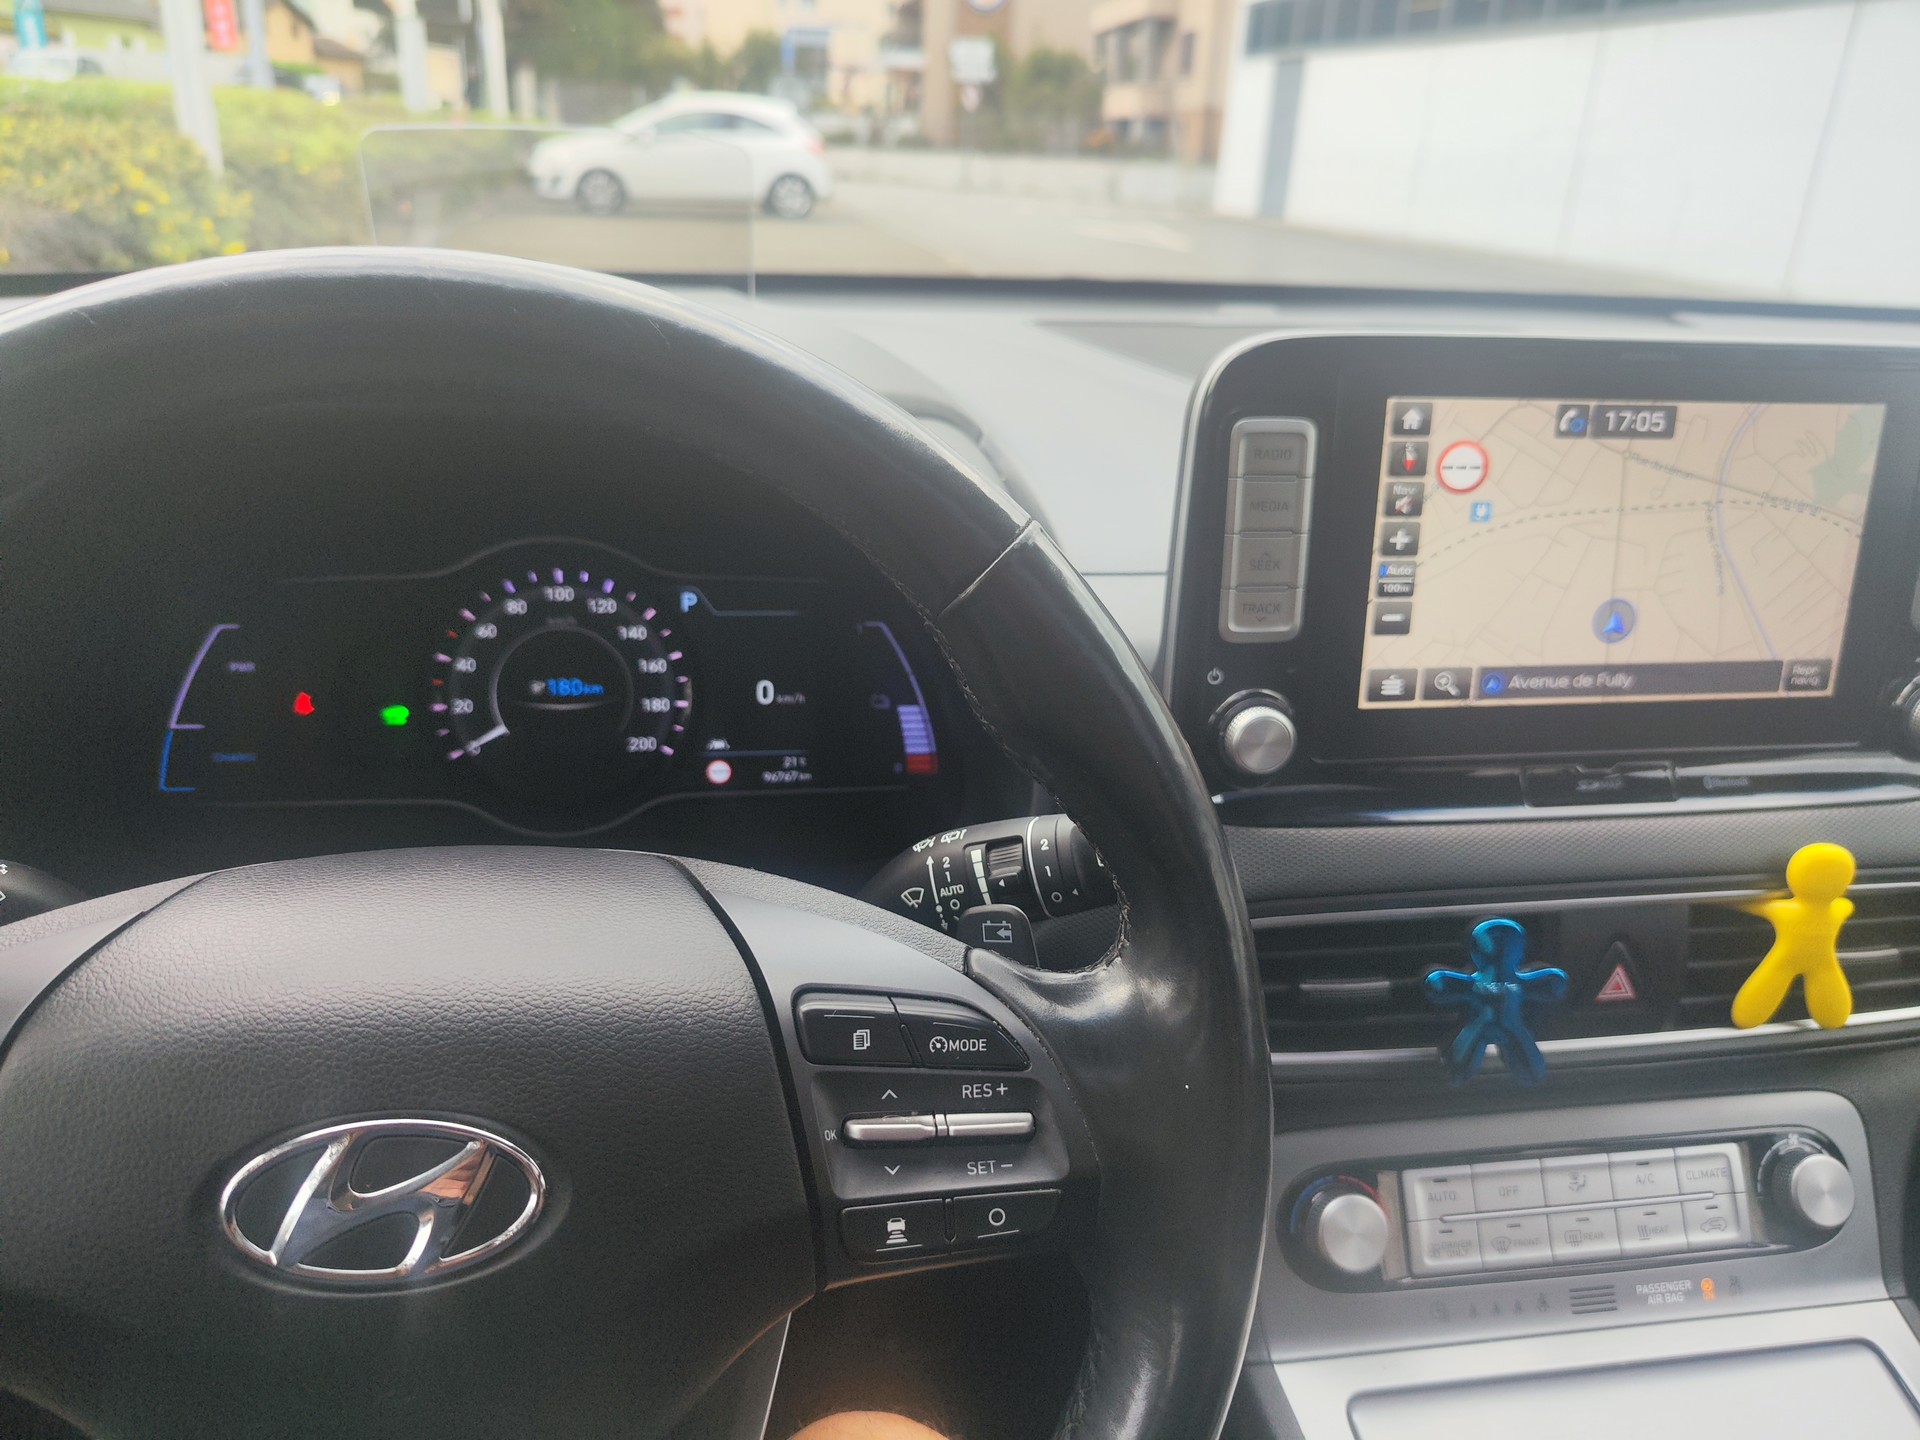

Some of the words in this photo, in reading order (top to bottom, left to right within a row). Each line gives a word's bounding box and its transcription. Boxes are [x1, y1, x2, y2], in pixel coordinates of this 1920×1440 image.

[1605, 411, 1665, 432] 17:05
[1254, 449, 1292, 461] RADIO
[1393, 484, 1416, 495] Nav
[1251, 501, 1289, 512] MEDIA
[1250, 559, 1280, 571] SEEK
[1386, 565, 1413, 576] Auto
[545, 586, 575, 601] 100
[1382, 584, 1410, 593] 100m
[504, 599, 528, 615] 80
[588, 598, 617, 614] 120
[680, 591, 698, 612] P
[1242, 604, 1280, 616] TRACK
[475, 623, 498, 640] 60
[617, 625, 648, 641] 140
[454, 656, 477, 674] 40
[638, 657, 668, 674] 160
[1508, 674, 1570, 690] Avenue
[1573, 672, 1594, 689] de
[1596, 671, 1632, 690] Fully
[756, 679, 775, 705] 0
[451, 698, 474, 715] 20
[642, 697, 670, 713] 180
[625, 736, 657, 753] 200
[1041, 839, 1048, 850] 2
[943, 857, 950, 868] 2
[945, 871, 950, 882] 1
[1045, 866, 1051, 877] 1
[940, 884, 964, 898] AUTO
[949, 1038, 987, 1052] MODE
[824, 1129, 837, 1141] OK
[967, 1161, 996, 1175] SET
[1686, 1167, 1728, 1181] CLIMATE
[1635, 1172, 1655, 1185] A/C
[1427, 1190, 1456, 1201] AUTO
[1498, 1185, 1519, 1197] OFF
[1636, 1280, 1692, 1295] PASSENGER
[1647, 1294, 1663, 1305] AIR
[1665, 1292, 1684, 1303] BAG
